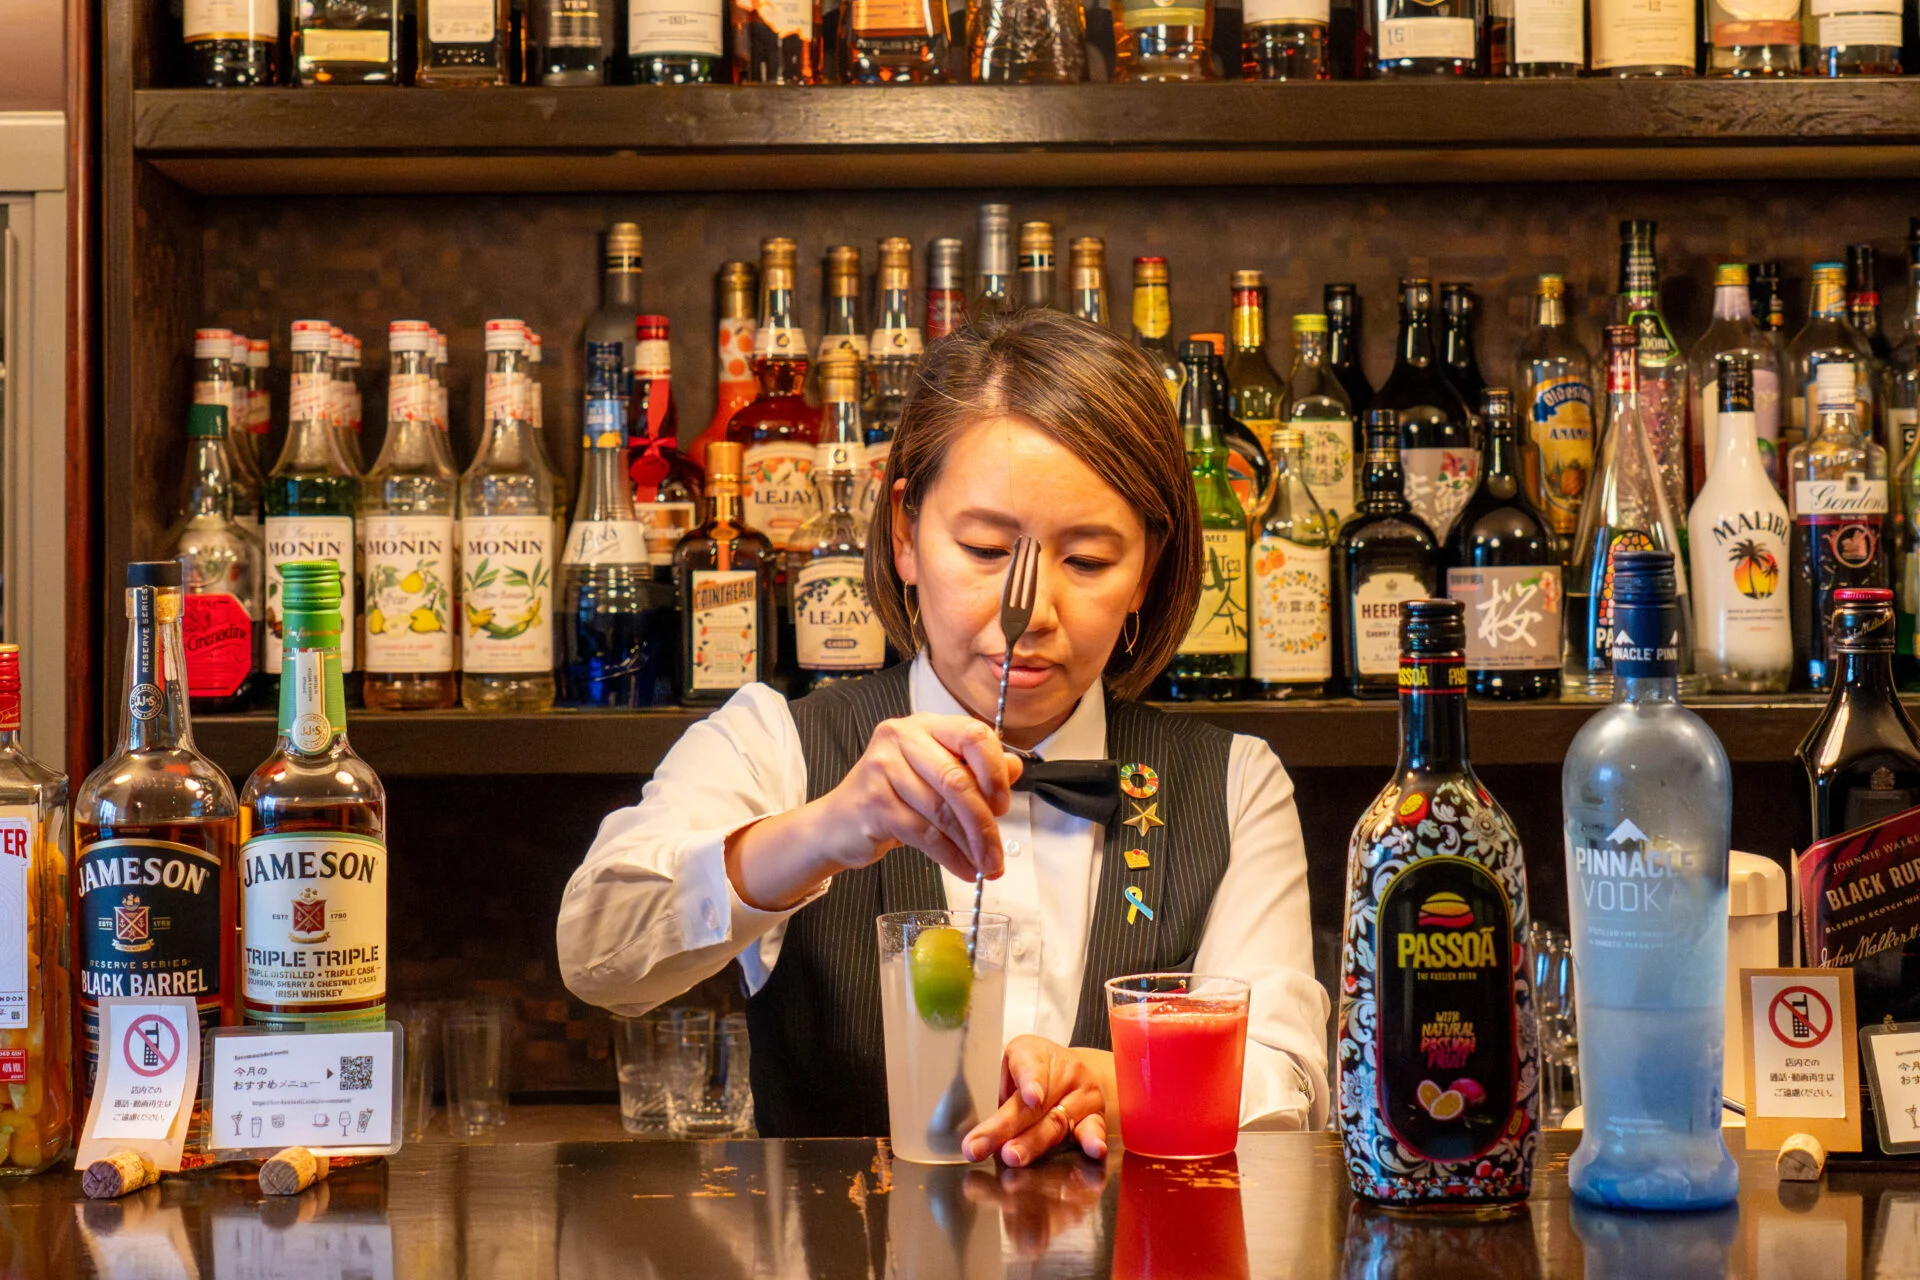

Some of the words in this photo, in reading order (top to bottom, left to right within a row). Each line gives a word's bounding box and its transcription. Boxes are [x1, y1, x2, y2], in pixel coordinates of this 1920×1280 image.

[269, 541, 342, 557] MONIN
[369, 540, 443, 556] MONIN
[468, 540, 543, 556] MONIN
[809, 610, 874, 625] LEJAY
[142, 628, 150, 673] RESERVE
[244, 851, 376, 888] JAMESON
[1833, 849, 1881, 875] JOHNNIE
[78, 857, 205, 897] JAMESON
[1825, 873, 1886, 911] BLACK
[1825, 915, 1867, 933] BLENDED
[1868, 901, 1904, 918] SCOTCH
[90, 959, 137, 970] RESERVE
[142, 958, 188, 968] SERIES
[246, 948, 306, 968] TRIPLE
[312, 945, 379, 968] TRIPLE
[270, 970, 315, 979] DISTILLED
[325, 968, 355, 978] TRIPLE
[357, 966, 375, 976] CASK
[81, 970, 125, 996] BLACK
[130, 968, 209, 997] BARREL
[277, 979, 309, 988] SHERRY
[317, 977, 357, 988] CHESTNUT
[275, 989, 299, 998] IRISH
[301, 988, 343, 998] WHISKEY
[1422, 1022, 1475, 1036] NATURAL
[233, 1066, 268, 1077] 今月の
[233, 1079, 321, 1091] おすすめメニュー
